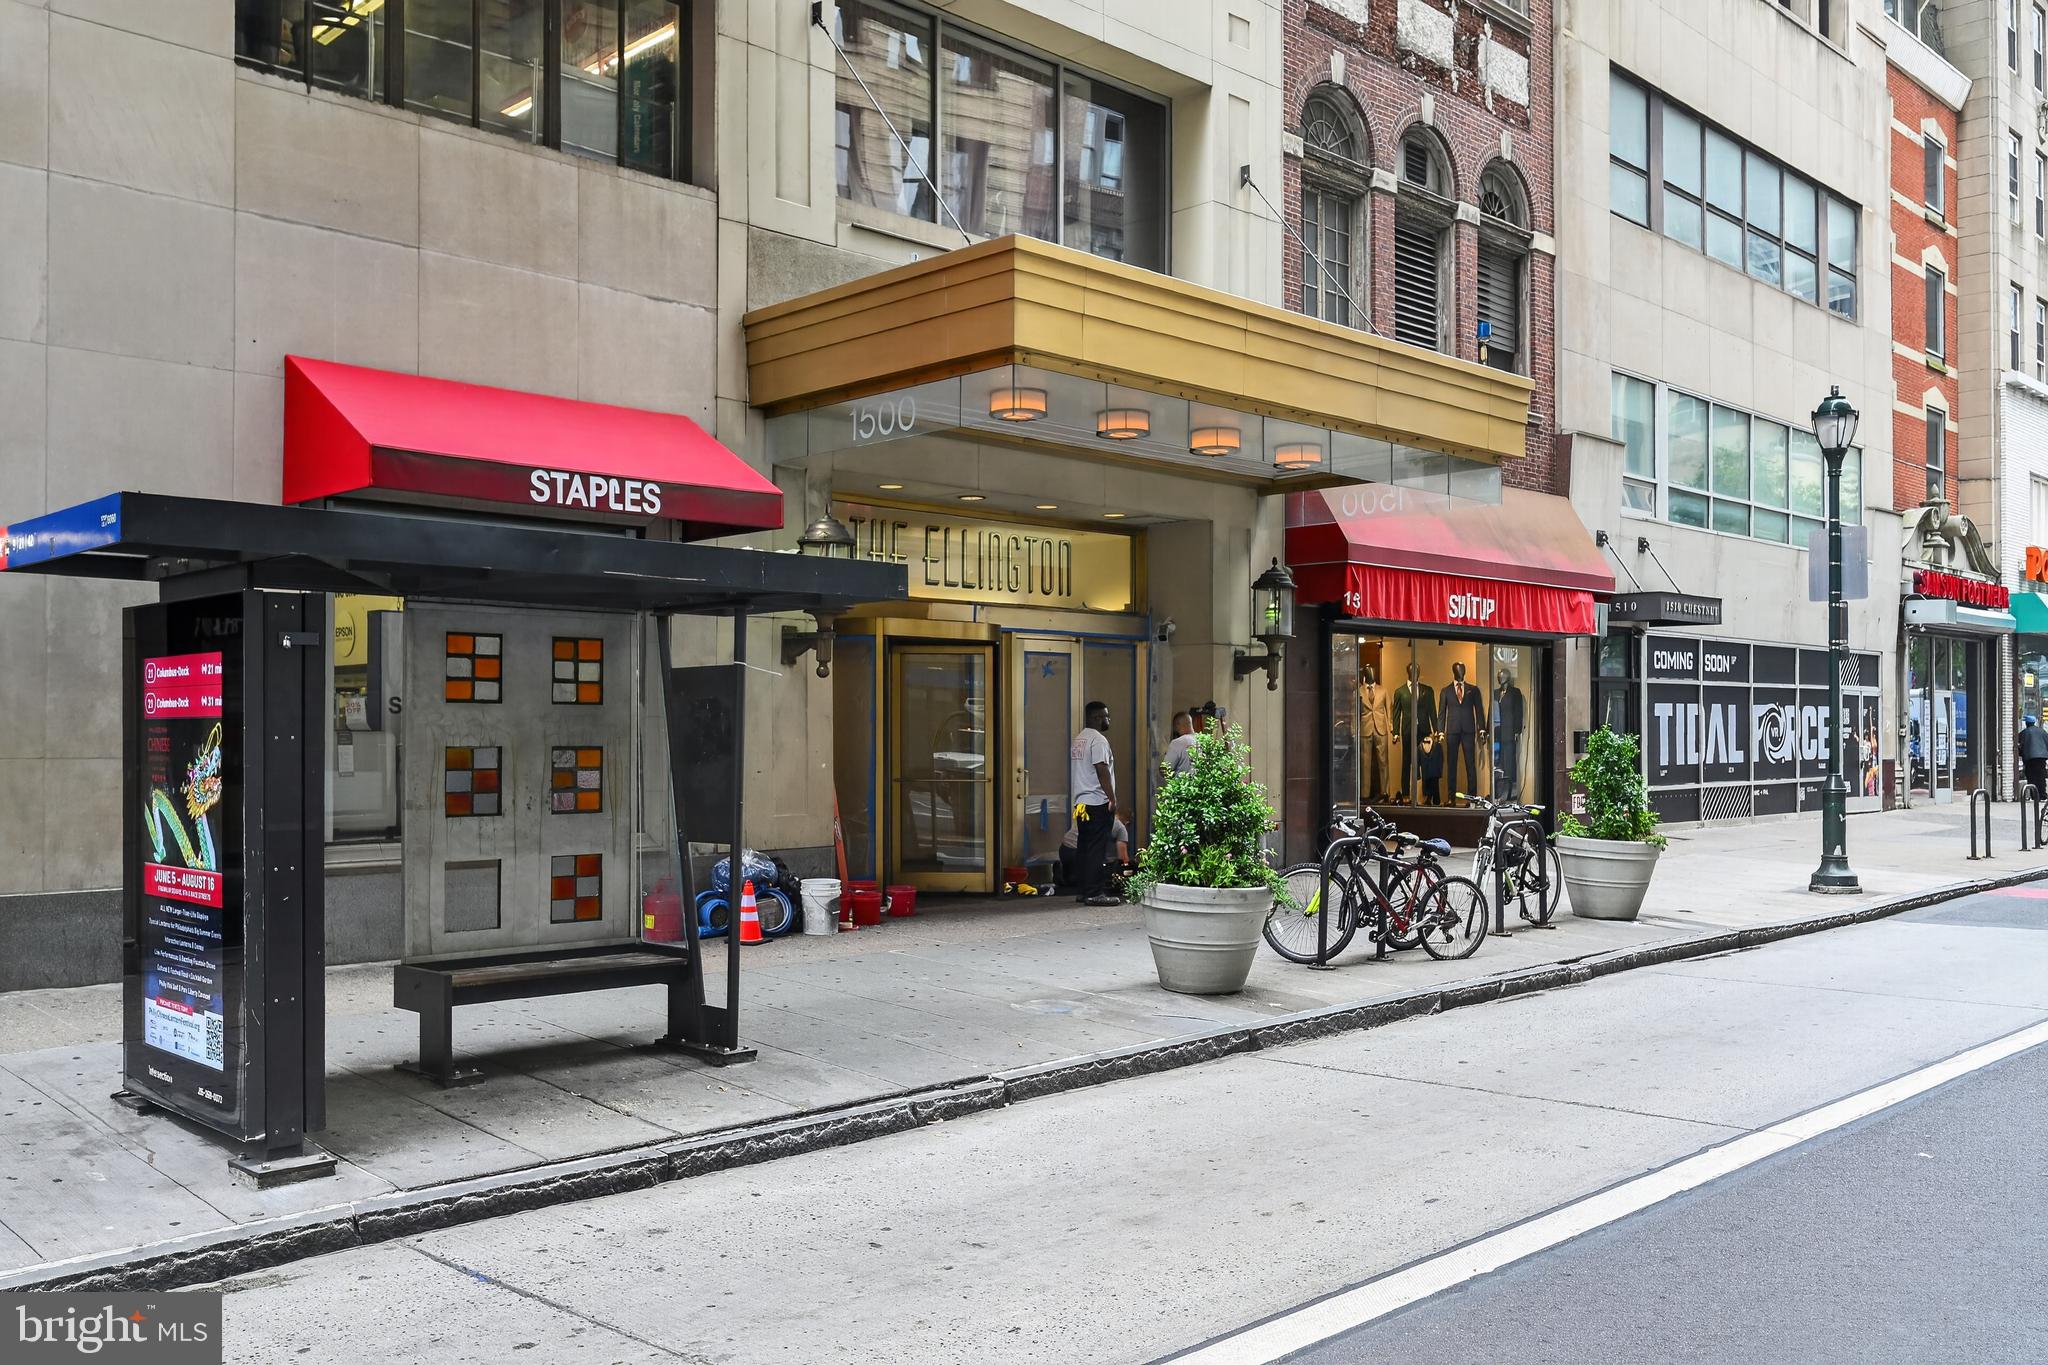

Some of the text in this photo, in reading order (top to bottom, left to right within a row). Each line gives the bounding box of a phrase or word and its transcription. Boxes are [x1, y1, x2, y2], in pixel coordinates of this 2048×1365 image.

[850, 396, 916, 440] 1500
[530, 469, 661, 514] STAPLES
[849, 516, 1072, 596] THE ELLINGTON
[1962, 578, 2008, 608] FOOTWEAR
[1666, 601, 1719, 616] 1510 CHESTNUT
[336, 626, 352, 638] EPSON
[148, 669, 154, 678] 21
[208, 664, 214, 674] 21
[1654, 650, 1694, 670] COMING
[1704, 654, 1730, 672] SOON
[148, 700, 154, 708] 21
[208, 696, 214, 706] 31
[1654, 703, 1744, 766] TIDAL
[1770, 727, 1779, 738] VR
[154, 870, 171, 884] JUNE
[172, 872, 176, 884] 5
[182, 873, 206, 890] AUGUST
[208, 876, 214, 892] 16
